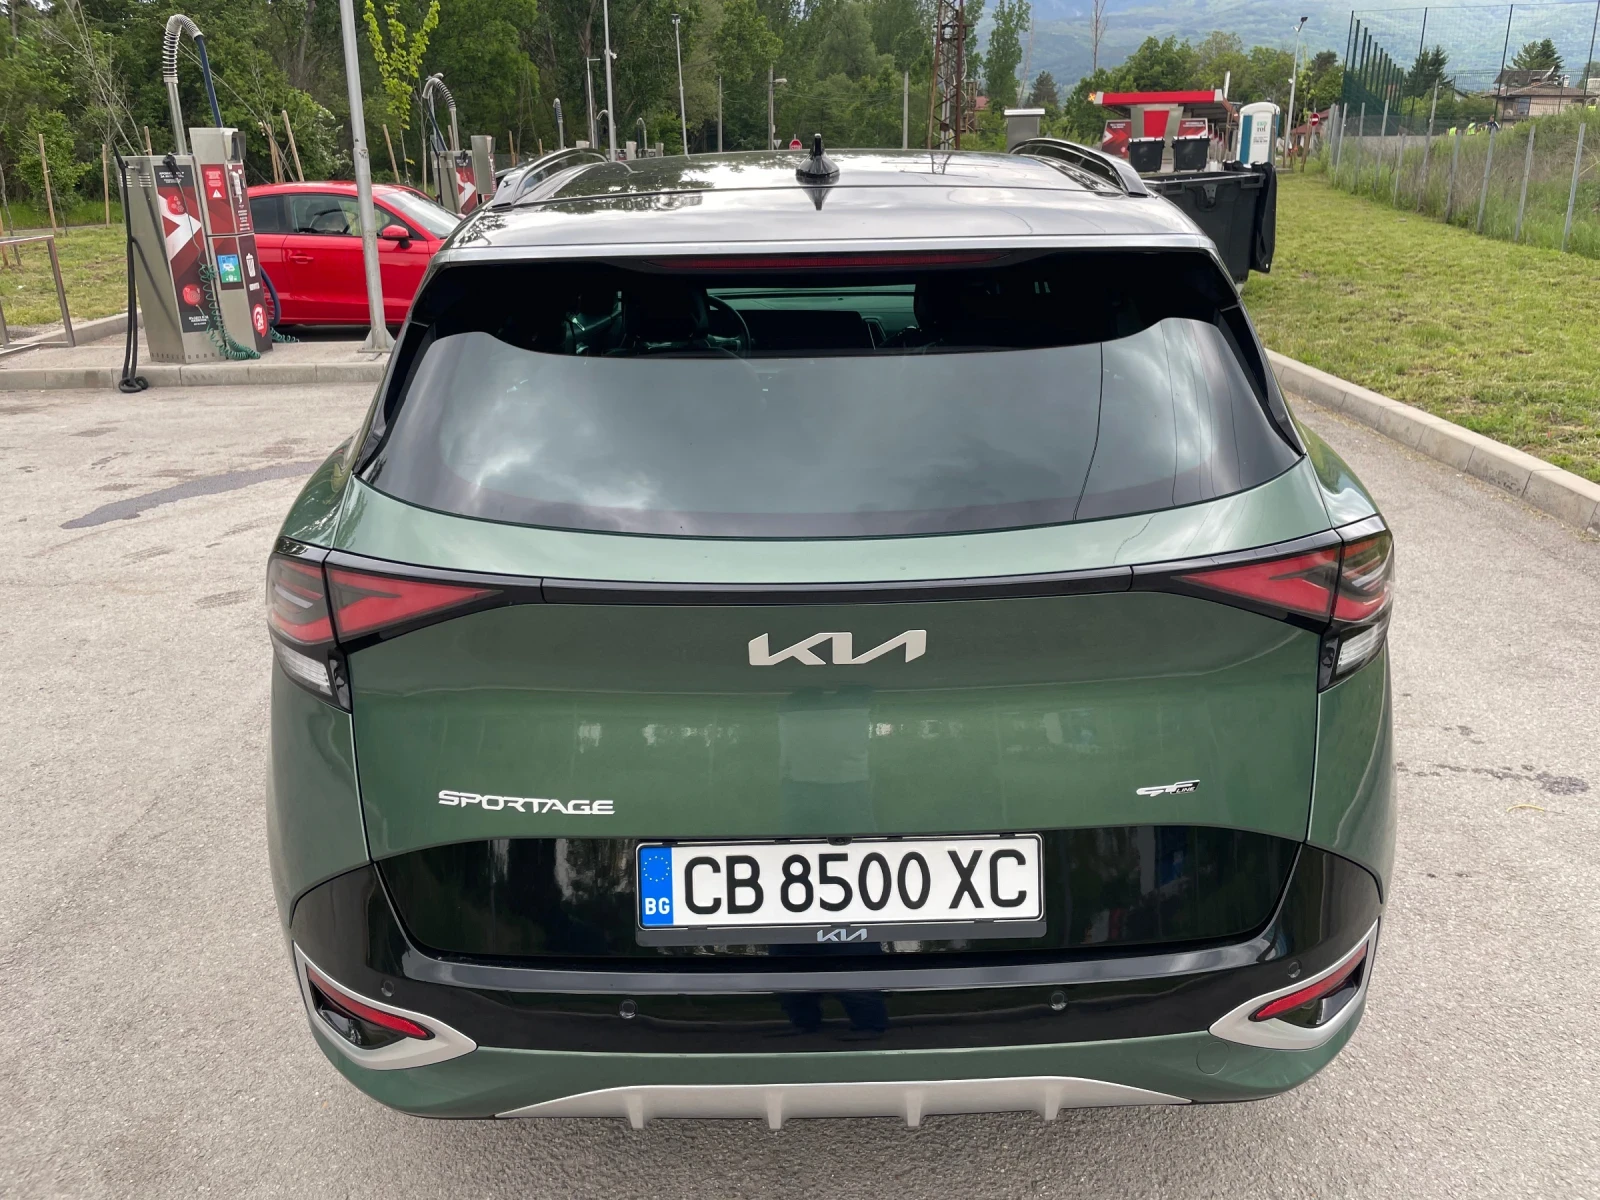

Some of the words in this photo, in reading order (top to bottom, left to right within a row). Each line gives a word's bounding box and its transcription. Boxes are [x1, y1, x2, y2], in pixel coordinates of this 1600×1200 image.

[748, 629, 927, 666] KIA
[438, 790, 616, 815] SPORTAGE
[684, 855, 764, 915] CB
[780, 851, 931, 913] 8500
[947, 849, 1027, 909] XC
[645, 897, 671, 915] BG
[816, 928, 868, 942] KIA
